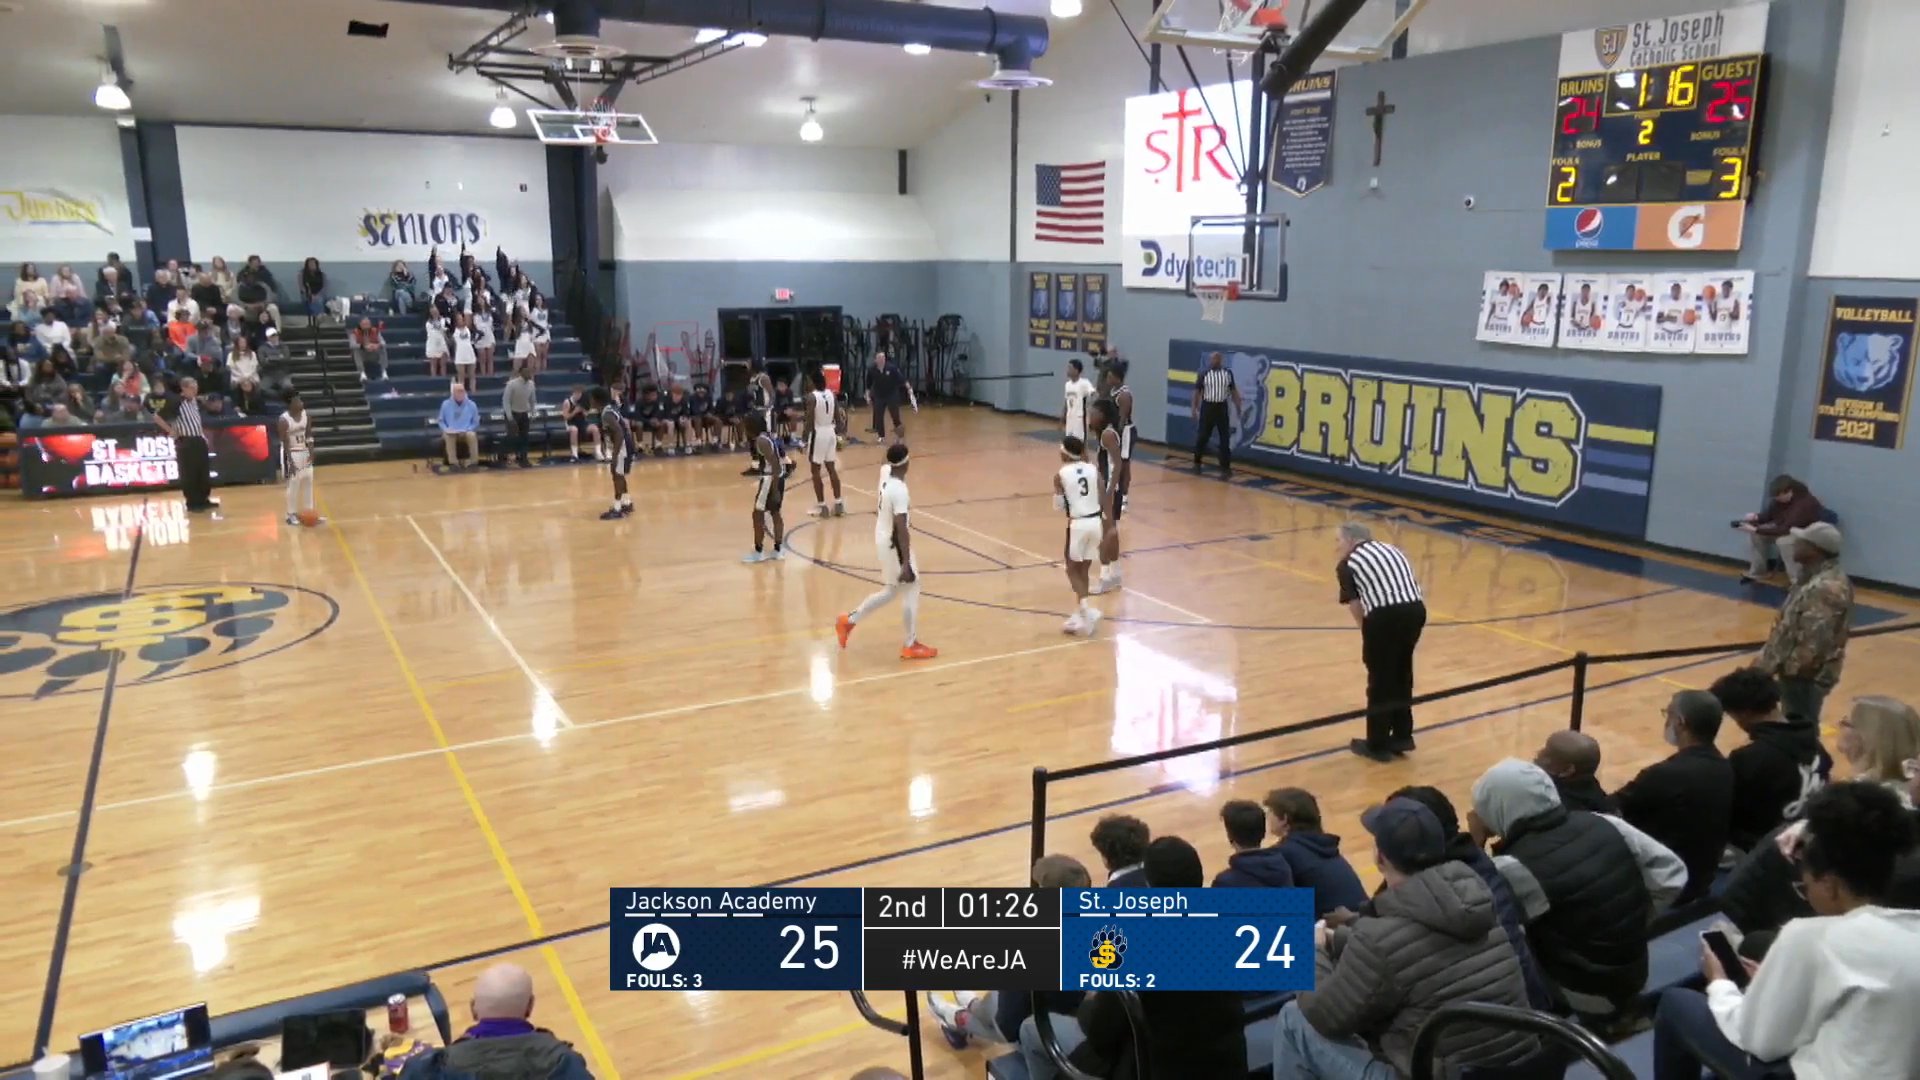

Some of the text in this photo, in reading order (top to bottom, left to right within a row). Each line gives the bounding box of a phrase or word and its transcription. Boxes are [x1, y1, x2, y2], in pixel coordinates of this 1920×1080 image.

[1658, 10, 1724, 44] Joseph
[1630, 38, 1721, 67] Catholic School
[1702, 62, 1756, 80] GUEST
[1561, 79, 1604, 96] BRUINS
[1705, 79, 1752, 123] 25
[1562, 96, 1602, 135] 24
[1638, 119, 1654, 145] 2
[1626, 152, 1661, 162] PLAYER
[1556, 166, 1576, 202] 2
[1718, 156, 1742, 199] 3
[1835, 308, 1914, 323] VOLLEYBALL
[1256, 363, 1584, 502] BRUINS
[1835, 420, 1875, 440] 2021
[1077, 477, 1089, 497] 3
